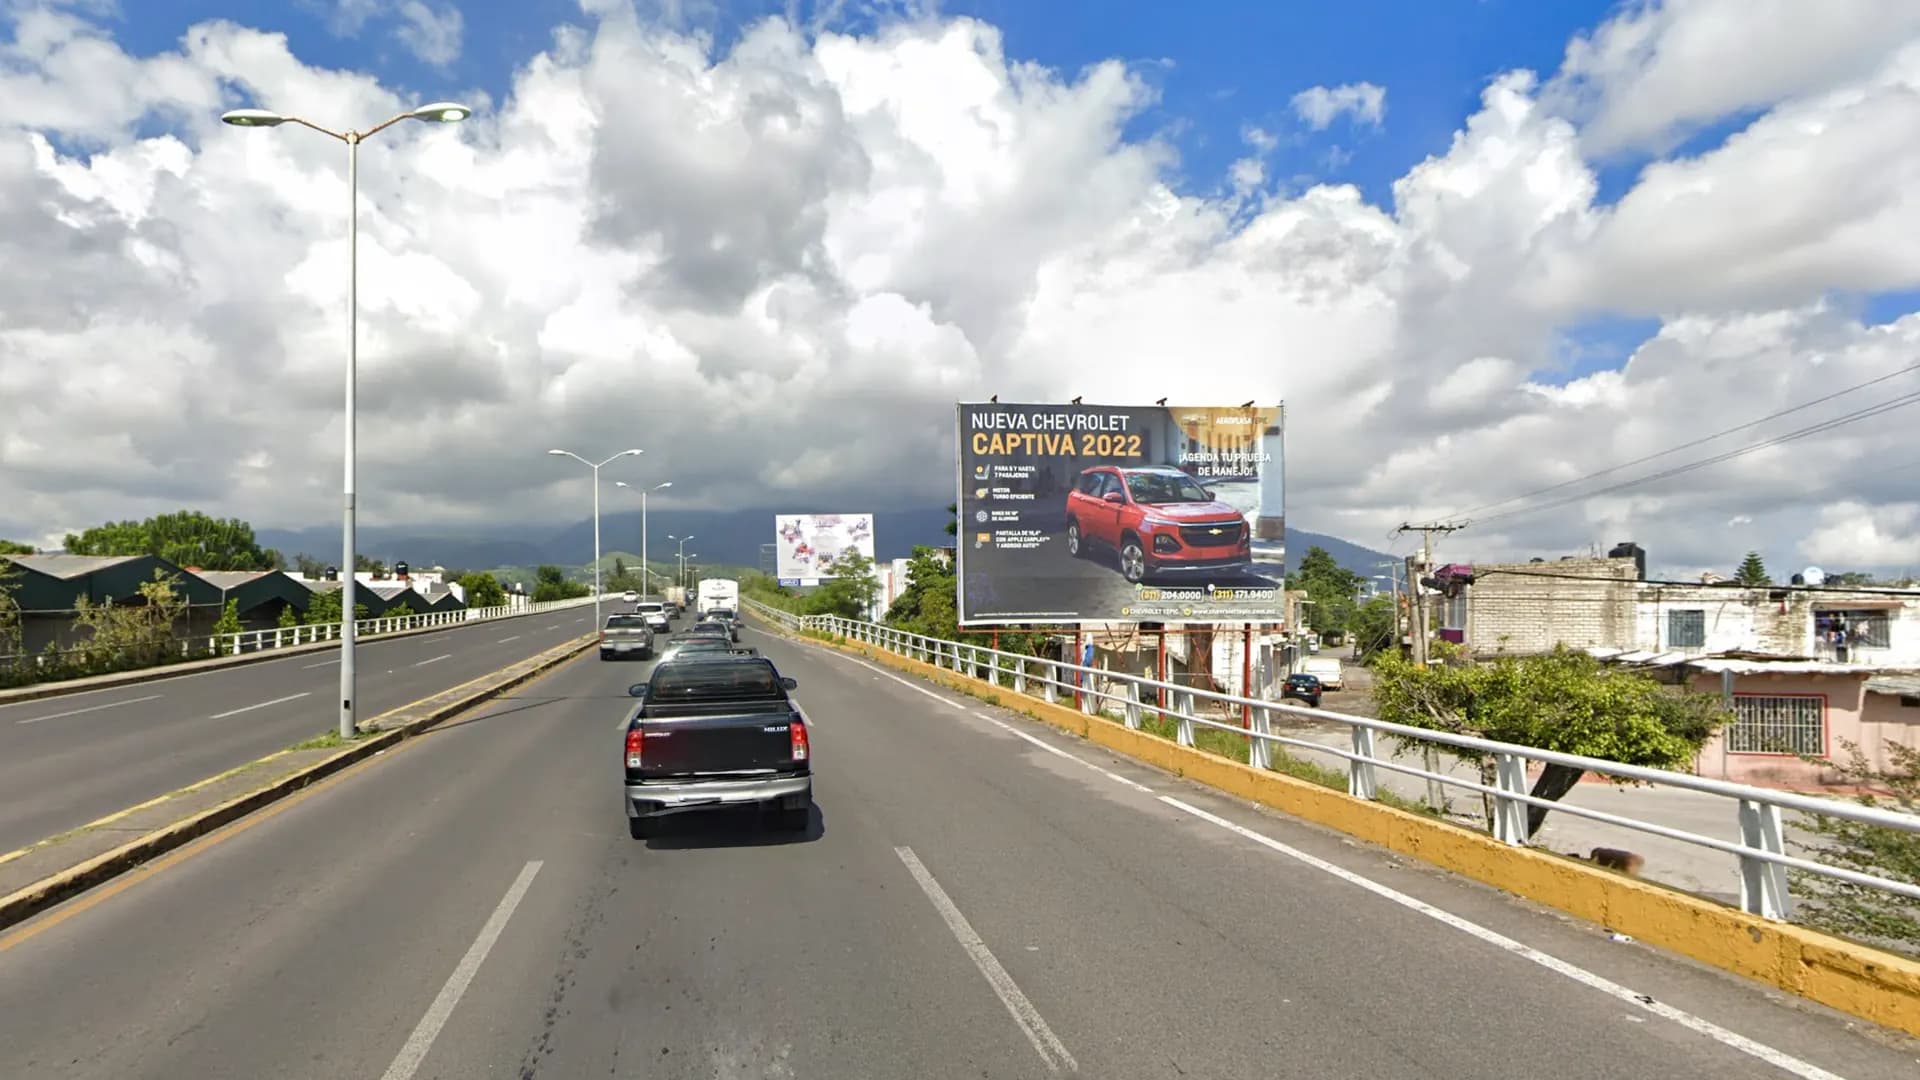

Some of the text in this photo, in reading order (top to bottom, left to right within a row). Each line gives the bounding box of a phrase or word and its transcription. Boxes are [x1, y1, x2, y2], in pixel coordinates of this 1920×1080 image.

[972, 413, 1130, 430] NUEVA CHEVROLET
[972, 432, 1142, 456] CAPTIVA 2022
[1178, 453, 1271, 462] ¡AGENDA TU PRUEBA
[1198, 467, 1253, 476] DE MANEJO!
[1213, 589, 1234, 600] (311)
